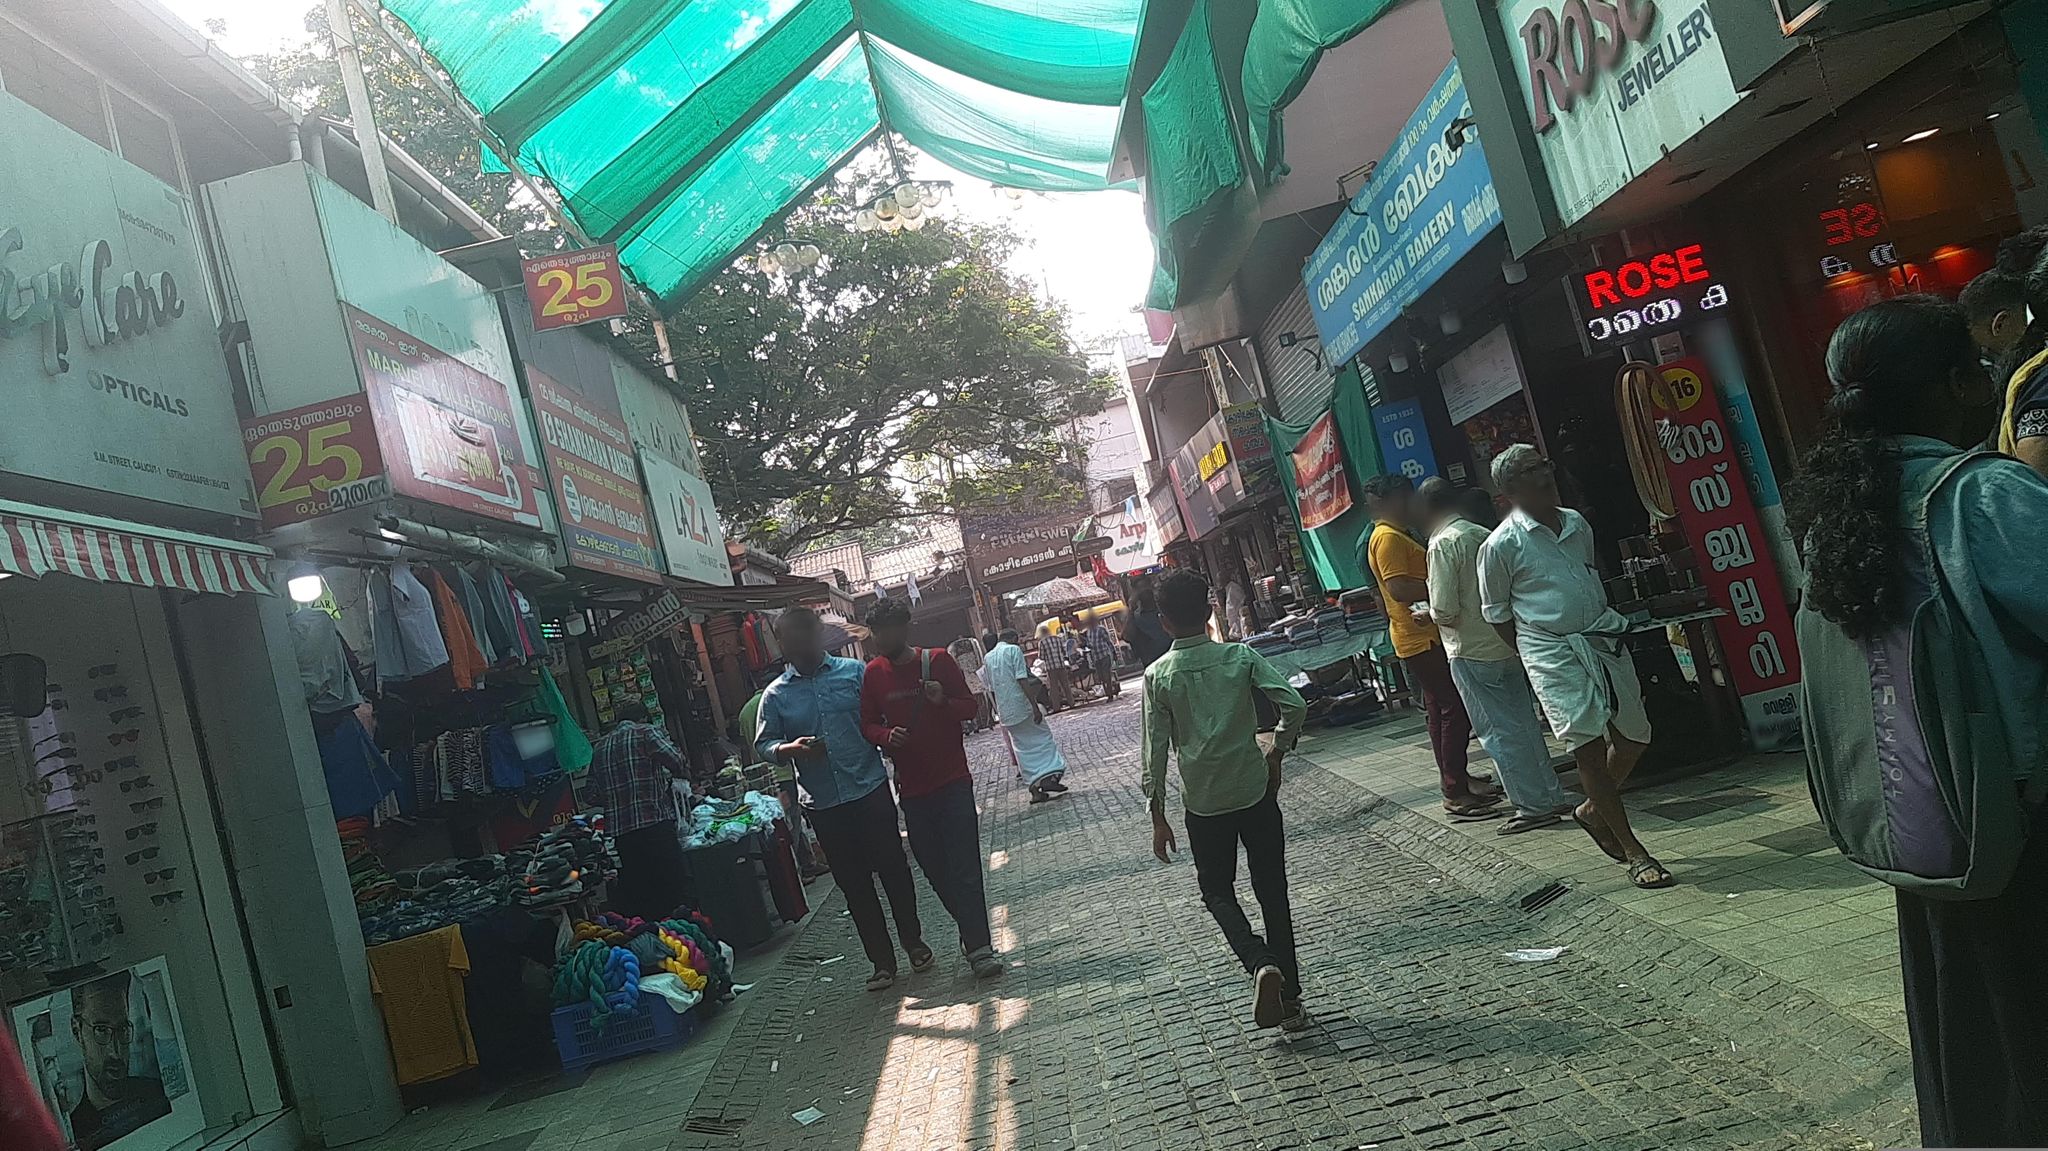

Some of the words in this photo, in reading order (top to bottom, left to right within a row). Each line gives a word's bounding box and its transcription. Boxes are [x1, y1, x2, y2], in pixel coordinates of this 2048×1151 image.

[1617, 5, 1712, 112] JEWELLER
[79, 240, 184, 350] Care
[537, 262, 612, 316] 25
[1317, 216, 1381, 312] ശങ്കരൻ
[1351, 255, 1407, 322] SANKARAN
[1405, 200, 1456, 270] BAKERY
[1584, 244, 1710, 309] ROSE
[87, 369, 189, 417] OPTICALS
[251, 421, 363, 509] 25
[554, 417, 611, 472] SHANKARAN
[670, 492, 714, 548] LAZA
[983, 546, 1055, 577] കോഴിക്കോടൻ
[1883, 711, 1903, 799] TOMMY
